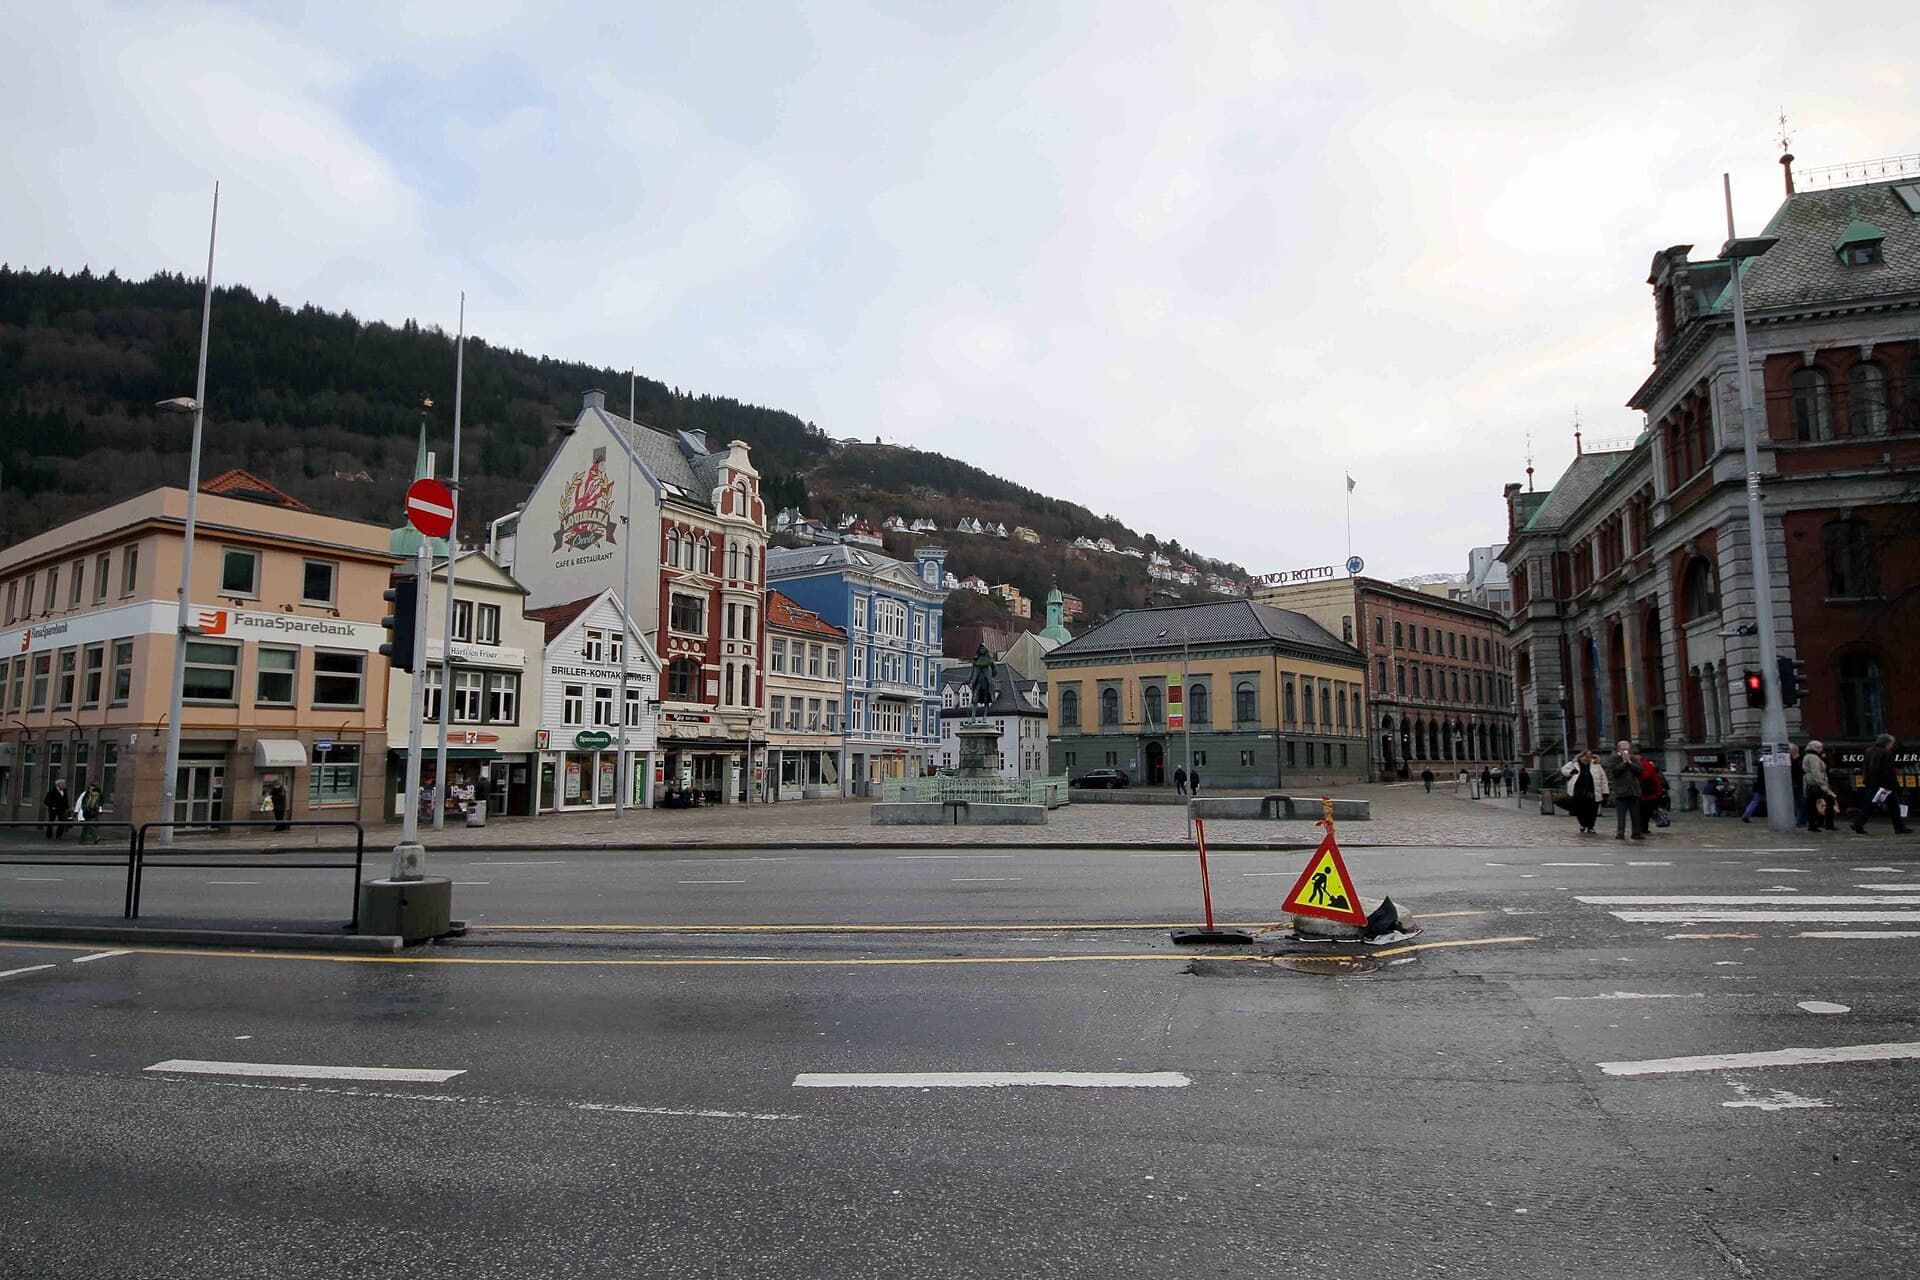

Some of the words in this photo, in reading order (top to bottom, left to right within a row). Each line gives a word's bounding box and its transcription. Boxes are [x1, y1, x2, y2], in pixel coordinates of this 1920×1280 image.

[576, 552, 614, 565] RESTAURANT
[1250, 572, 1288, 585] BANCO
[1291, 566, 1334, 580] ROTTO
